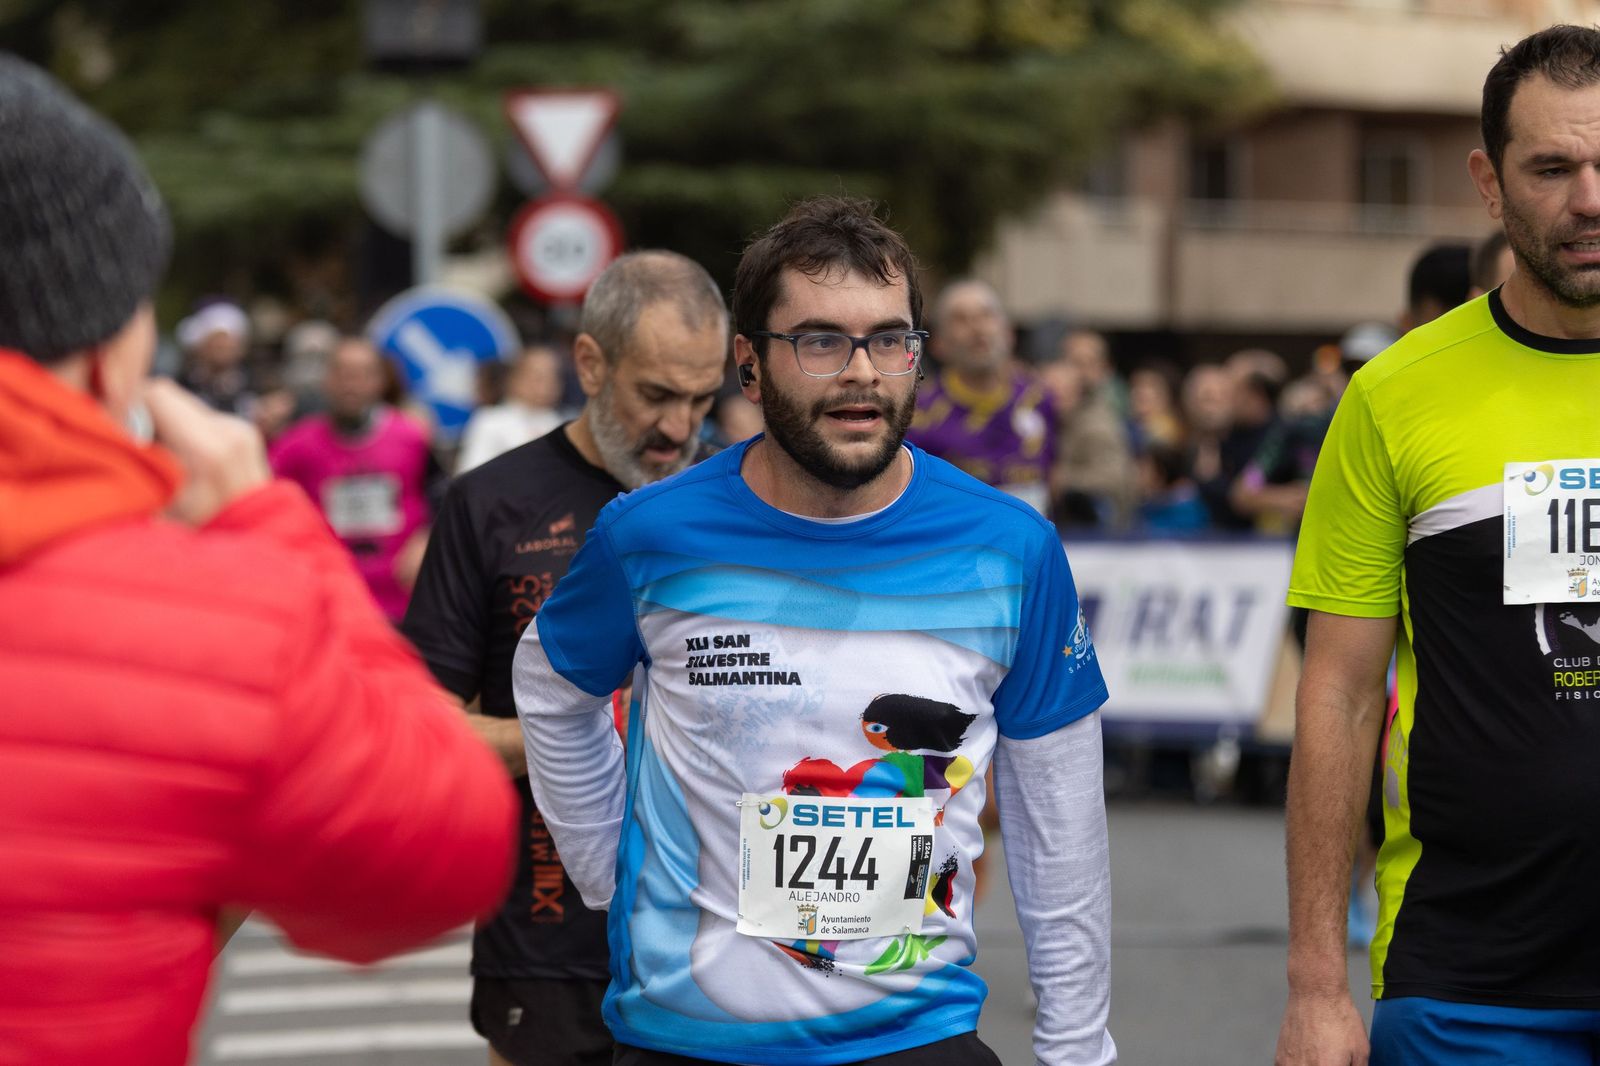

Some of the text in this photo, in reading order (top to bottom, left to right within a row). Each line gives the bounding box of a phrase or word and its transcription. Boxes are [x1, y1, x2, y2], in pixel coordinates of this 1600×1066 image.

[685, 634, 751, 651] XLI SAN
[685, 653, 770, 668] SILVESTRE
[1553, 656, 1591, 668] CLUB
[688, 671, 802, 686] SALMANTINA
[792, 804, 915, 828] SETEL
[773, 834, 879, 891] 1244
[788, 890, 861, 903] ALEJANDRO
[821, 914, 872, 925] Ayuntamiento
[820, 925, 870, 935] de Salamanca
